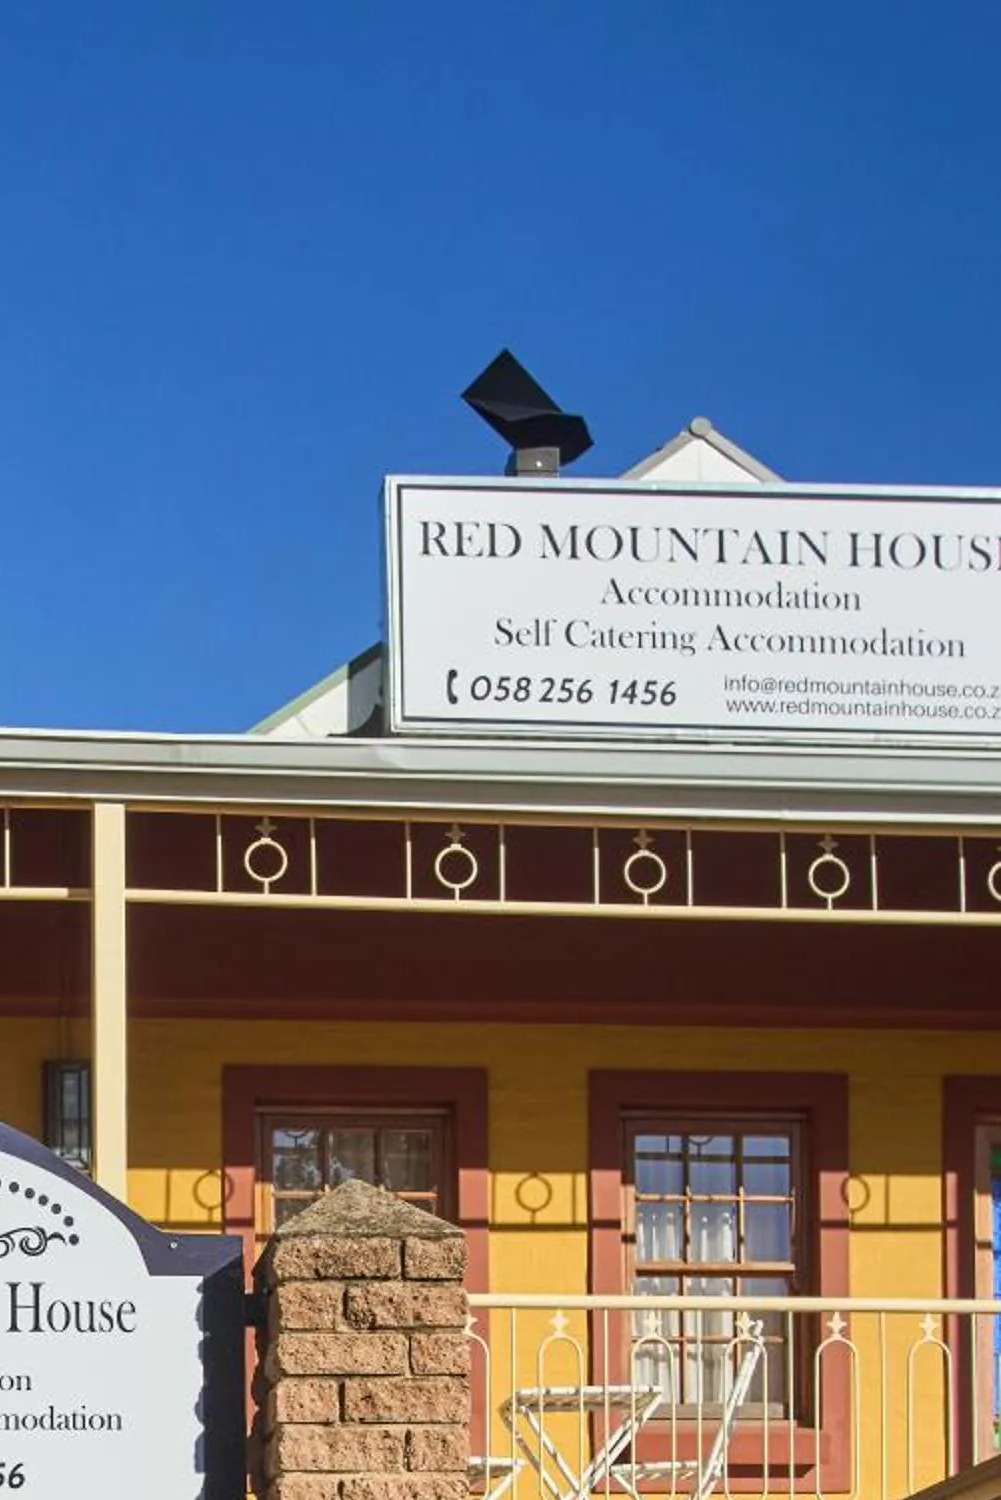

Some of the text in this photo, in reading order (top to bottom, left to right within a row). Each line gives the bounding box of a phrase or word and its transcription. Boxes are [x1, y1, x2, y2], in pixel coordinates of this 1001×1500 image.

[419, 521, 522, 558] RED
[539, 524, 829, 567] MOUNTAIN
[600, 578, 862, 611] Accommodation
[494, 617, 966, 658] Self Catering Accommodation
[470, 675, 677, 706] 058 256 1456
[723, 674, 1001, 699] info@redmountainhouse.co.z
[726, 697, 1001, 720] www.redmountainhouse.co.z
[5, 1281, 137, 1333] House
